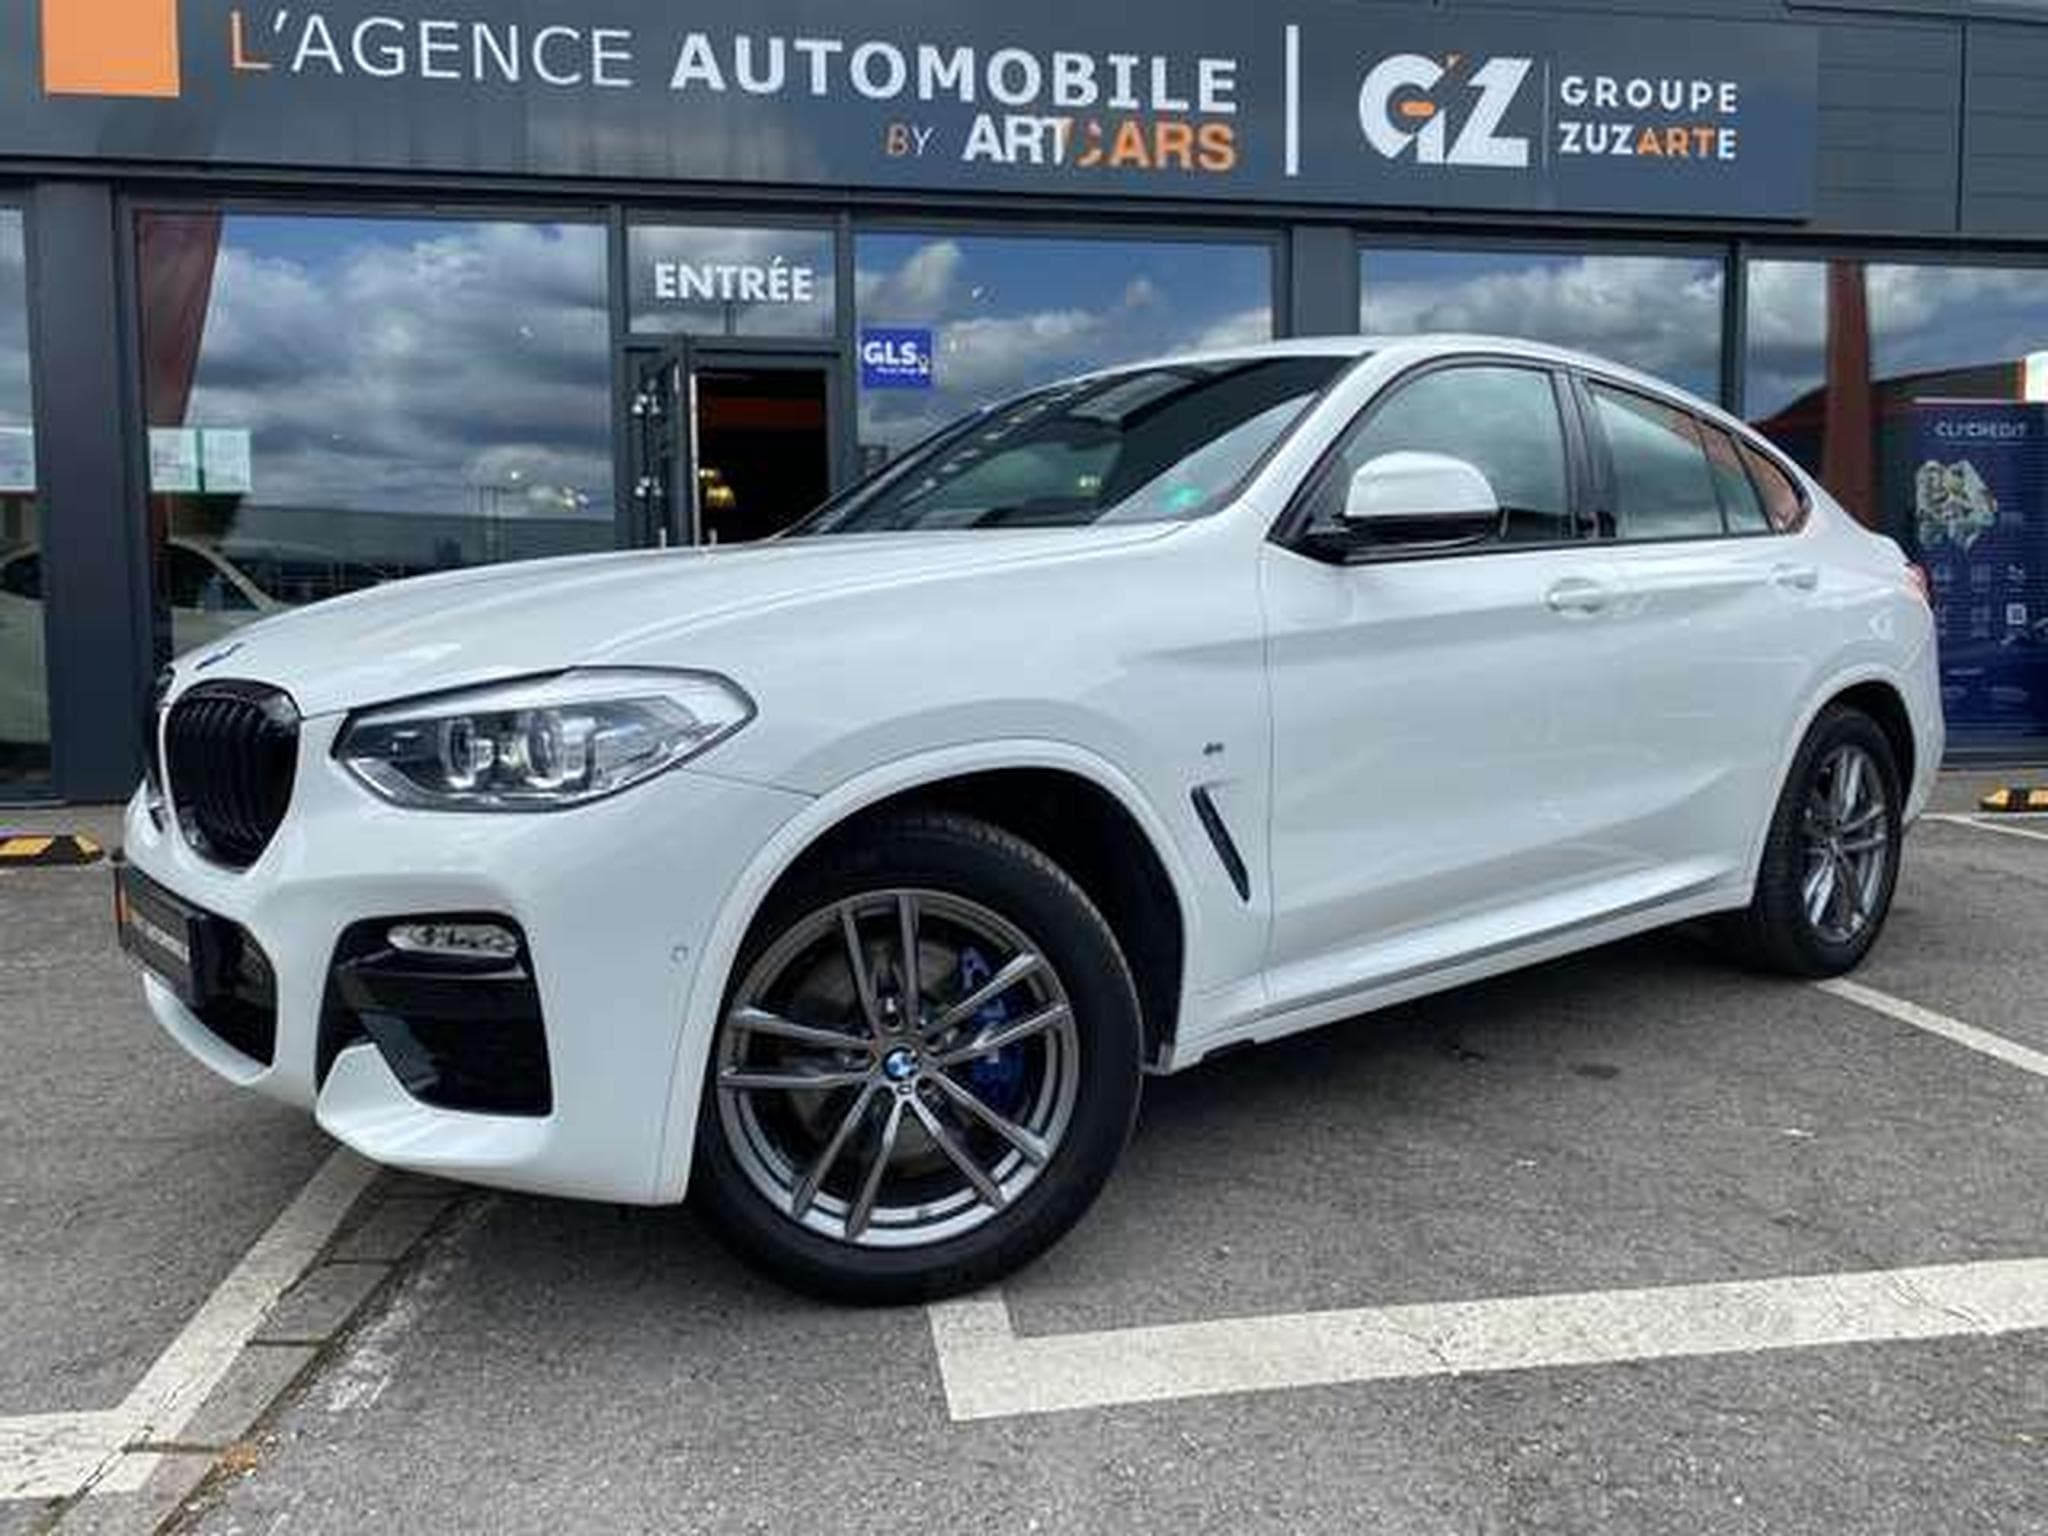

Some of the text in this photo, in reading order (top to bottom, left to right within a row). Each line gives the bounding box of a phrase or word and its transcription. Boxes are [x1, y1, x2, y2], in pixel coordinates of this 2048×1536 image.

[230, 10, 1238, 114] L'AGENCE AUTOMOBILE
[1560, 76, 1738, 113] GROUPE
[887, 124, 932, 156] BY
[1558, 121, 1737, 160] ZUZARTE
[654, 255, 814, 301] ENTRÉE
[863, 341, 918, 366] GLS
